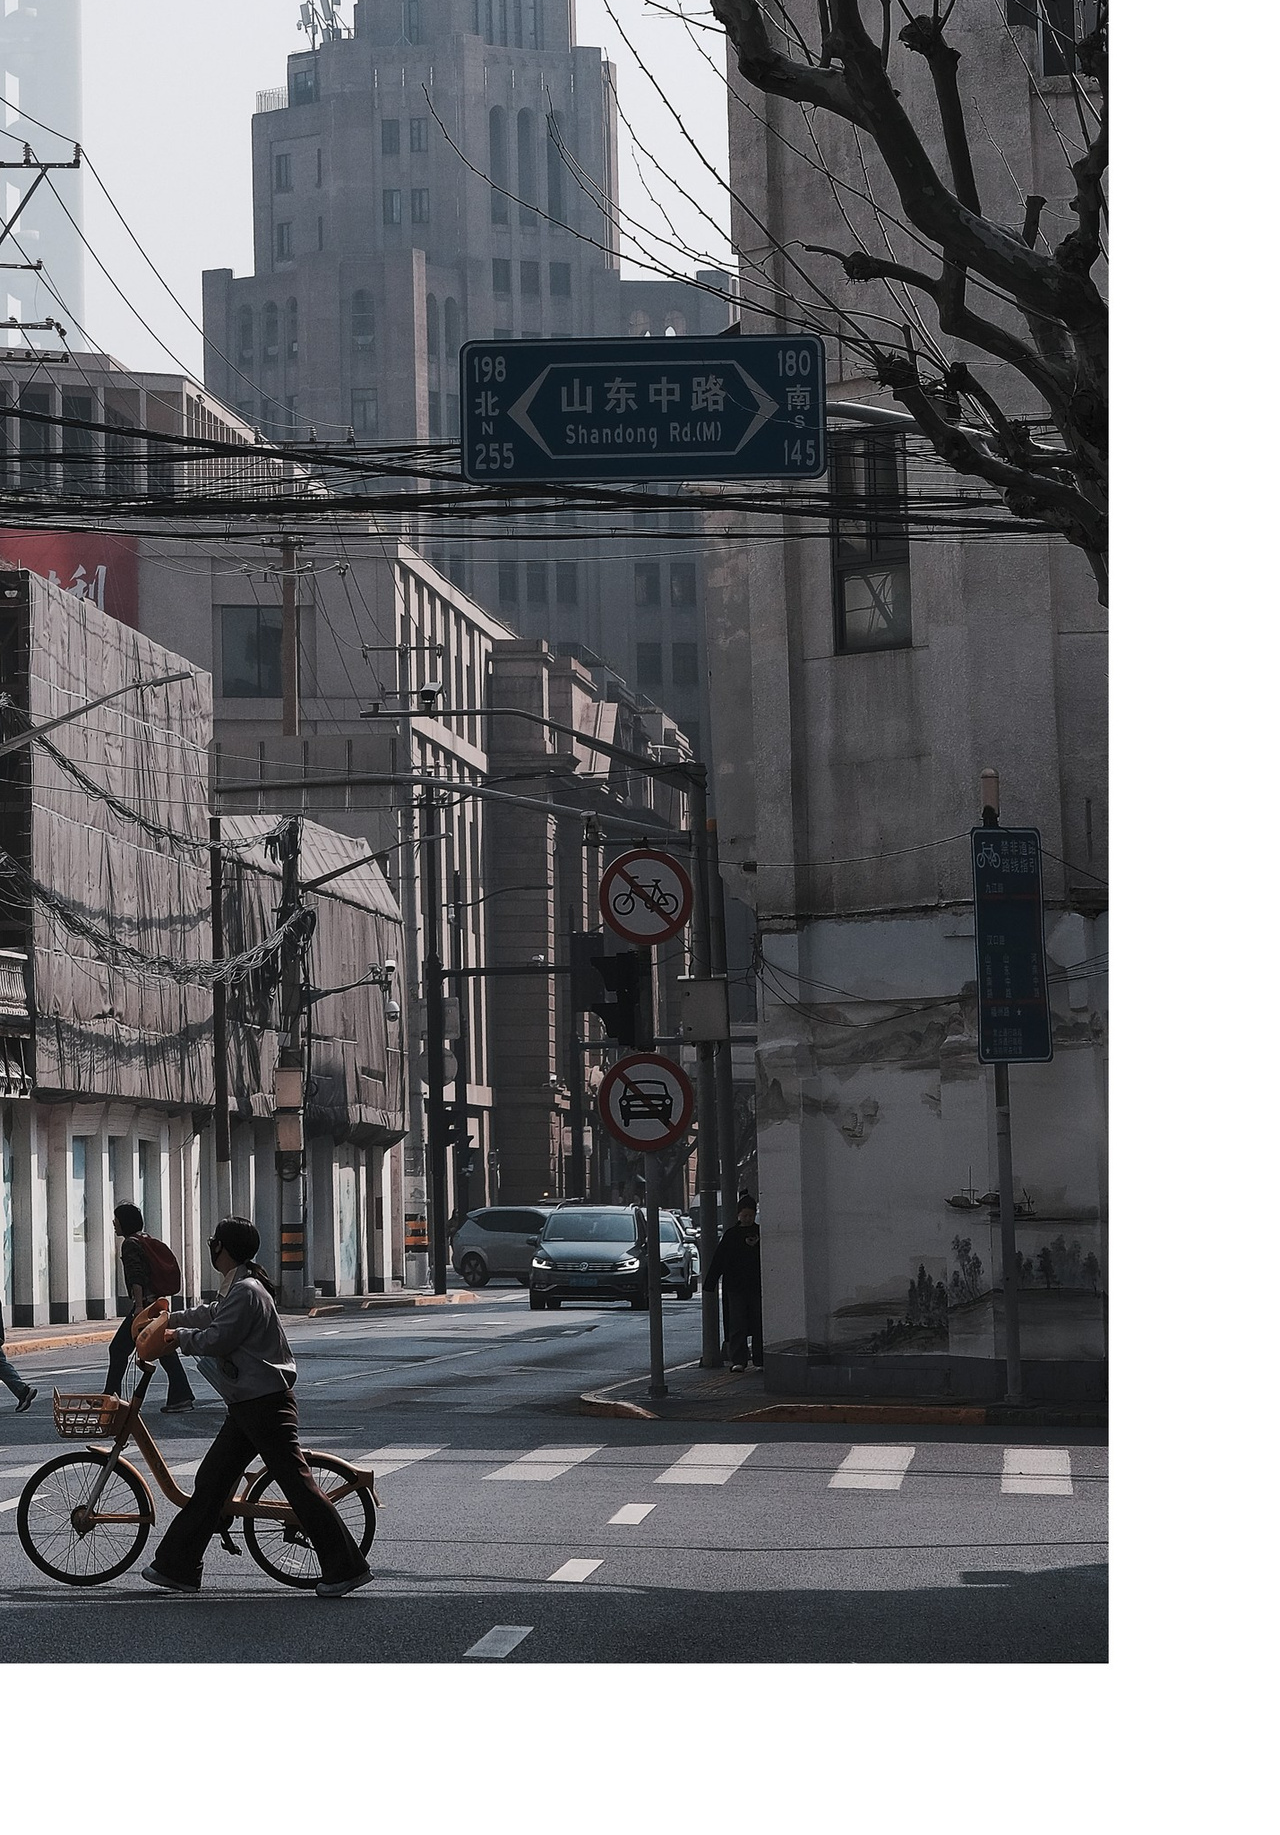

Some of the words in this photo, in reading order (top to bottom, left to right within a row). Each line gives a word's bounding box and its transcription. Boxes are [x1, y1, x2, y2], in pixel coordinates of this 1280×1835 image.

[473, 356, 506, 383] 198
[778, 350, 811, 376] 180
[475, 391, 500, 417] 北
[560, 375, 727, 414] 山东中路
[786, 384, 811, 411] 南
[481, 421, 494, 436] N
[565, 423, 658, 449] Shandong
[670, 421, 722, 443] Rd.(M)
[795, 415, 806, 429] S
[475, 443, 515, 470] 255
[783, 439, 816, 466] 145
